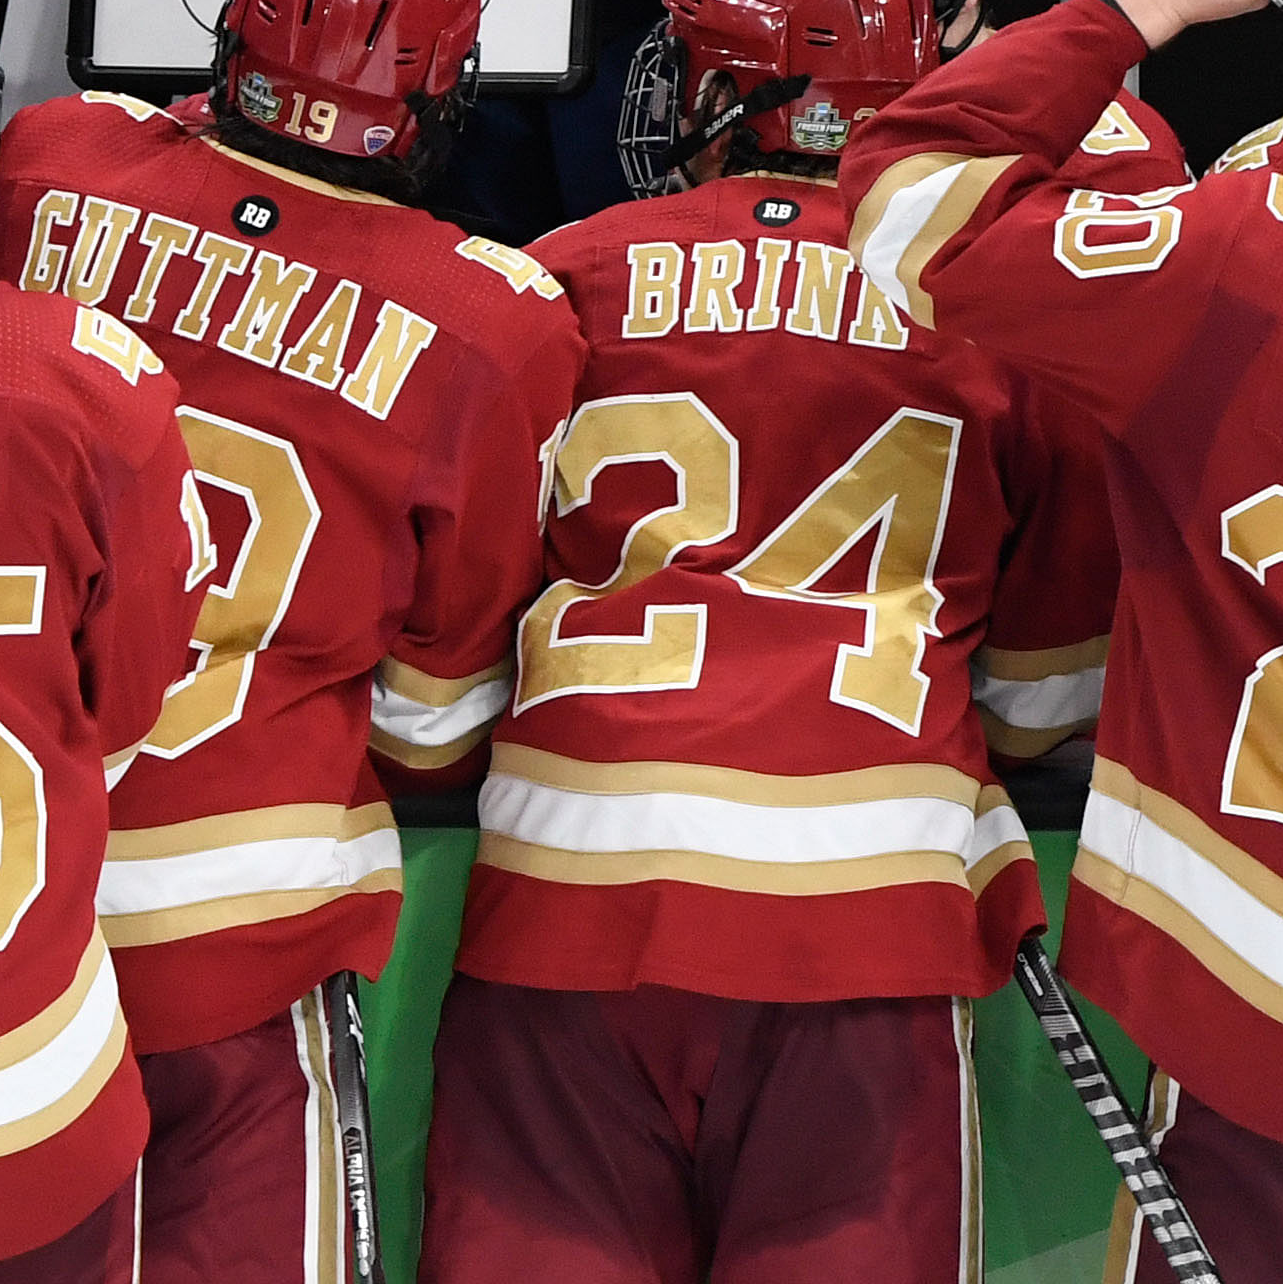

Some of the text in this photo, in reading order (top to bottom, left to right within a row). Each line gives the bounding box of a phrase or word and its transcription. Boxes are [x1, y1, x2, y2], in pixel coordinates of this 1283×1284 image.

[284, 92, 338, 143] 19
[703, 103, 744, 140] BAUER
[240, 203, 271, 230] RB
[763, 201, 793, 221] RB
[19, 190, 438, 421] GUTTMAN
[139, 404, 323, 760] 9
[514, 391, 964, 738] 24
